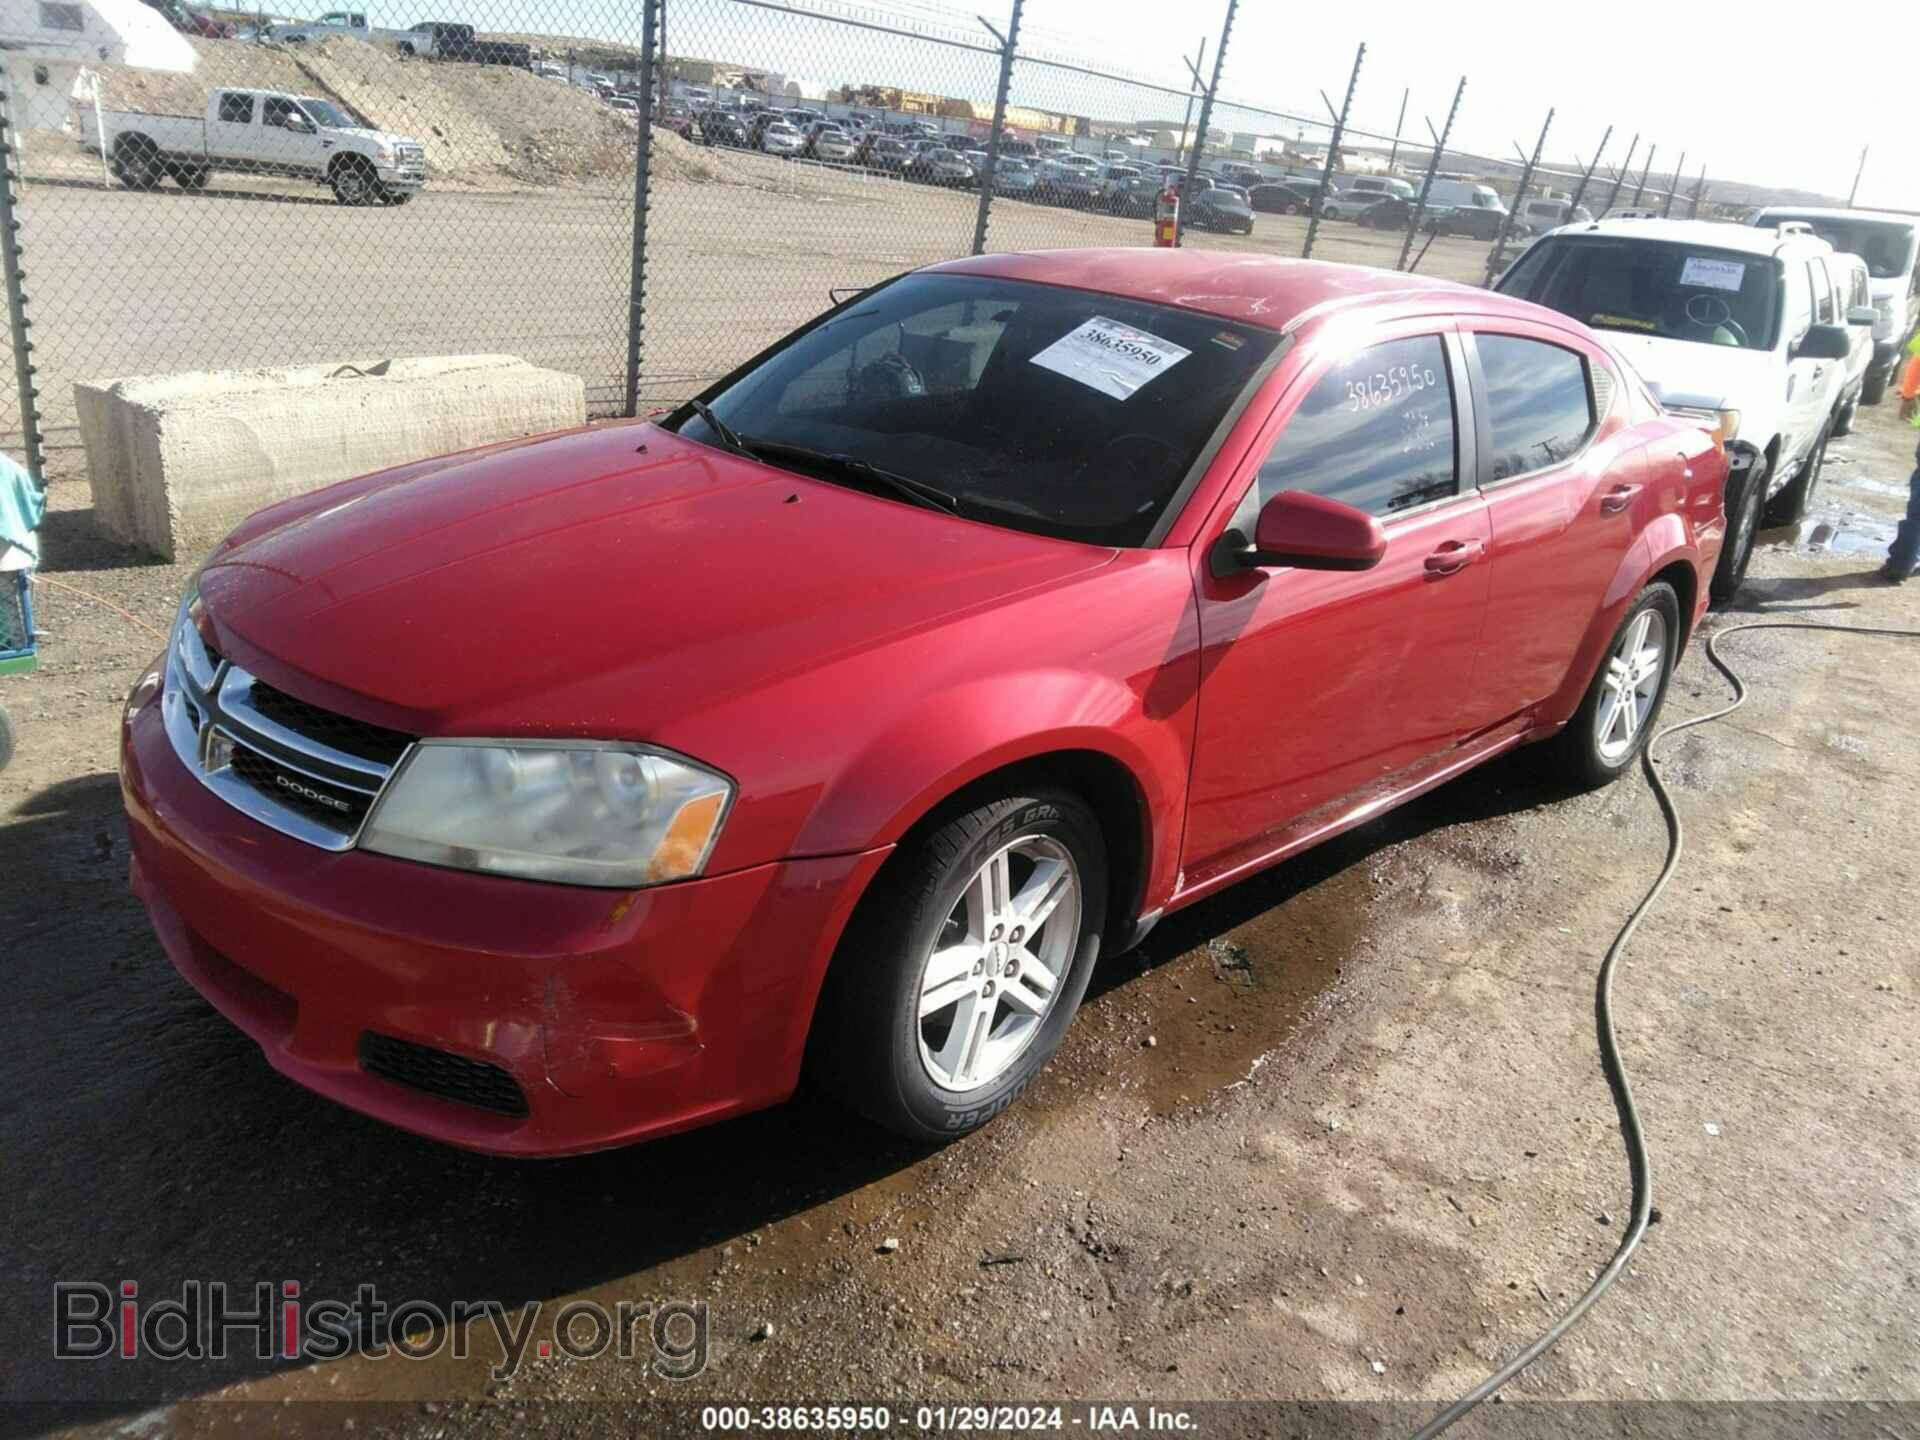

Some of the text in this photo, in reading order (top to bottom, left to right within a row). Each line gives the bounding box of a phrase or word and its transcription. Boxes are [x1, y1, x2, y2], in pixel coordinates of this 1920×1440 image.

[1080, 329, 1162, 365] 38635950
[1346, 364, 1435, 412] 38635950
[276, 775, 350, 812] DODGE
